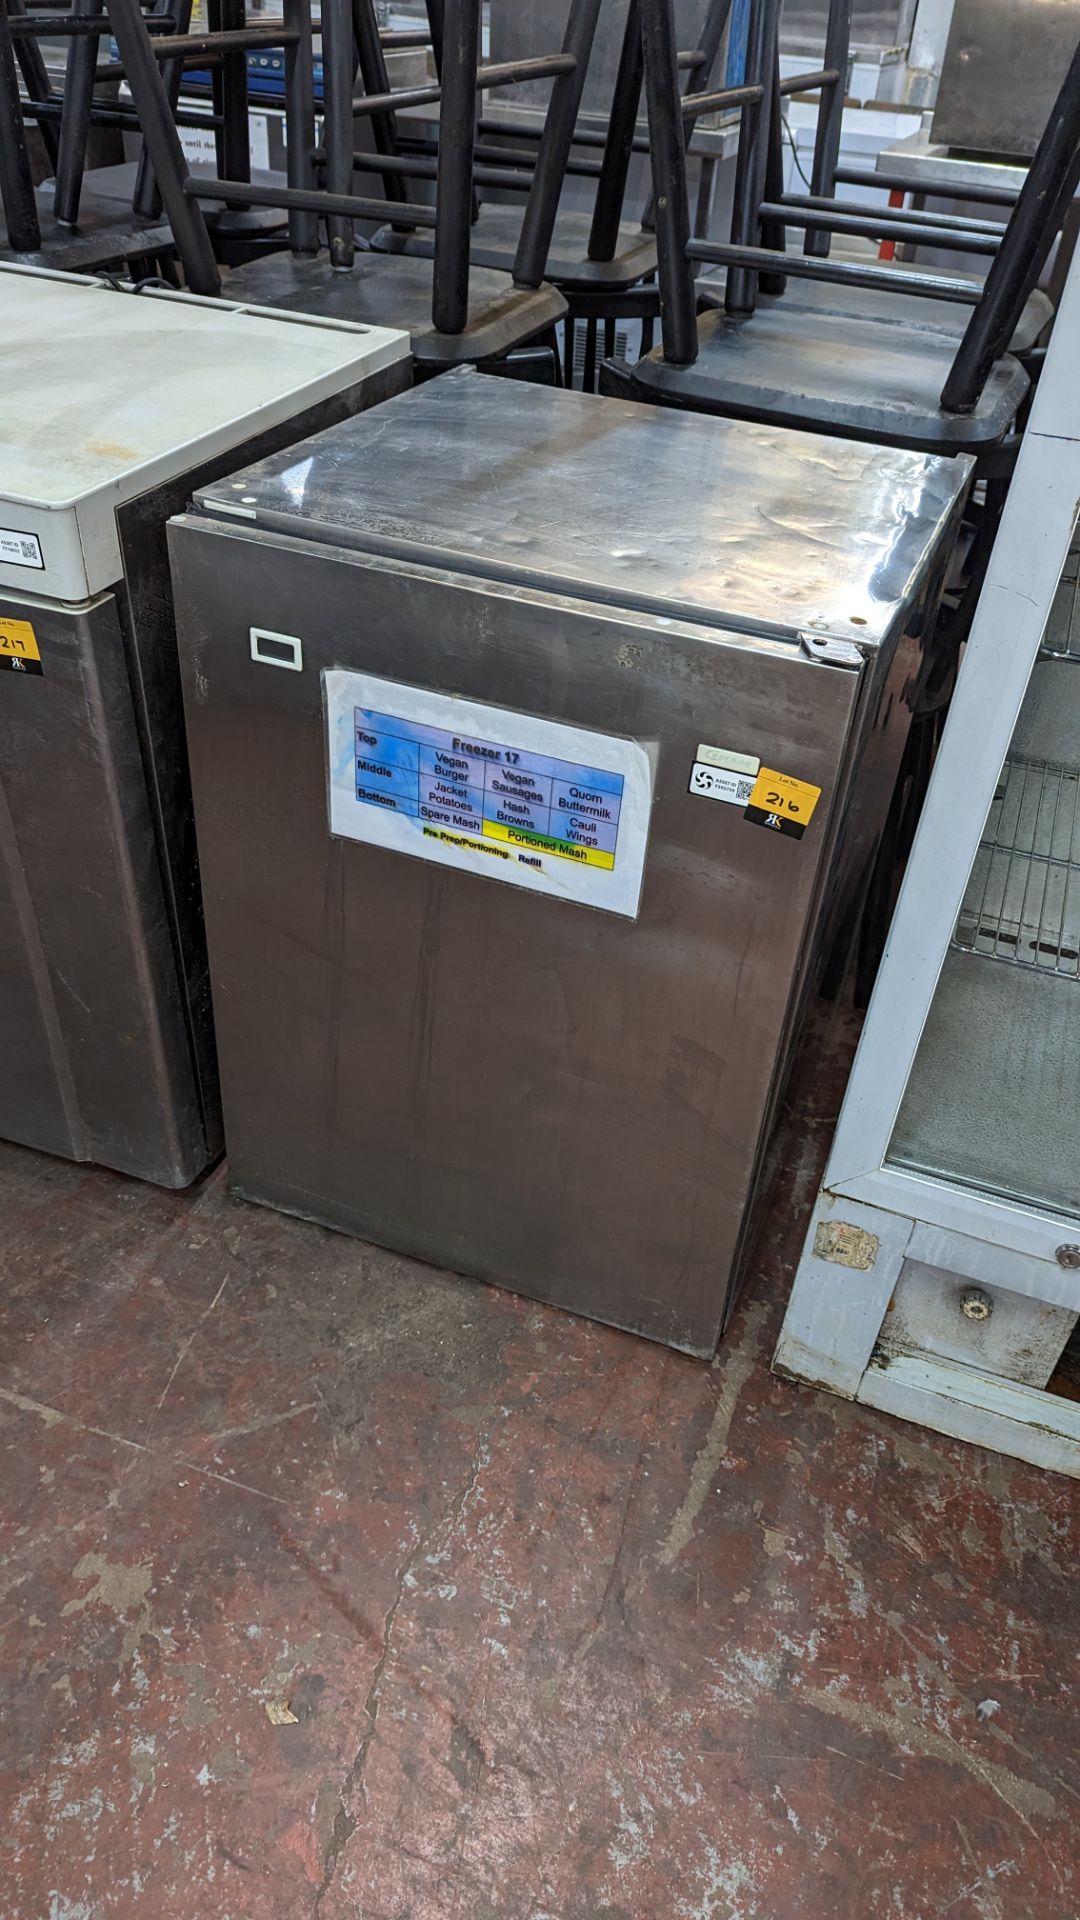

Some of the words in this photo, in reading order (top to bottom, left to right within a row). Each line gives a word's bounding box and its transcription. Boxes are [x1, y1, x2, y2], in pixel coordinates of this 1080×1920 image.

[0, 636, 26, 652] 217
[357, 730, 377, 747] Top
[452, 738, 501, 761] Freezer
[504, 750, 520, 764] 17
[357, 760, 393, 778] Middle
[435, 752, 469, 770] Vegan
[434, 764, 470, 784] Burger
[501, 769, 536, 787] Vegan
[779, 776, 789, 784] Lot
[358, 788, 396, 808] Bottom
[434, 781, 468, 799] Jacket
[492, 780, 544, 802] Sausages
[569, 787, 603, 804] Quorn
[428, 792, 473, 812] Potatoes
[503, 799, 530, 815] Hash
[558, 797, 612, 820] Buttermilk
[766, 791, 800, 813] 216
[420, 806, 451, 826] Spare
[453, 814, 481, 831] Mash
[497, 811, 535, 830] Browns
[569, 818, 597, 833] Cauli
[423, 826, 439, 840] Pre
[518, 854, 542, 868] Refill
[507, 829, 557, 852] Portioned
[559, 842, 588, 860] Mash
[566, 829, 599, 847] Wings
